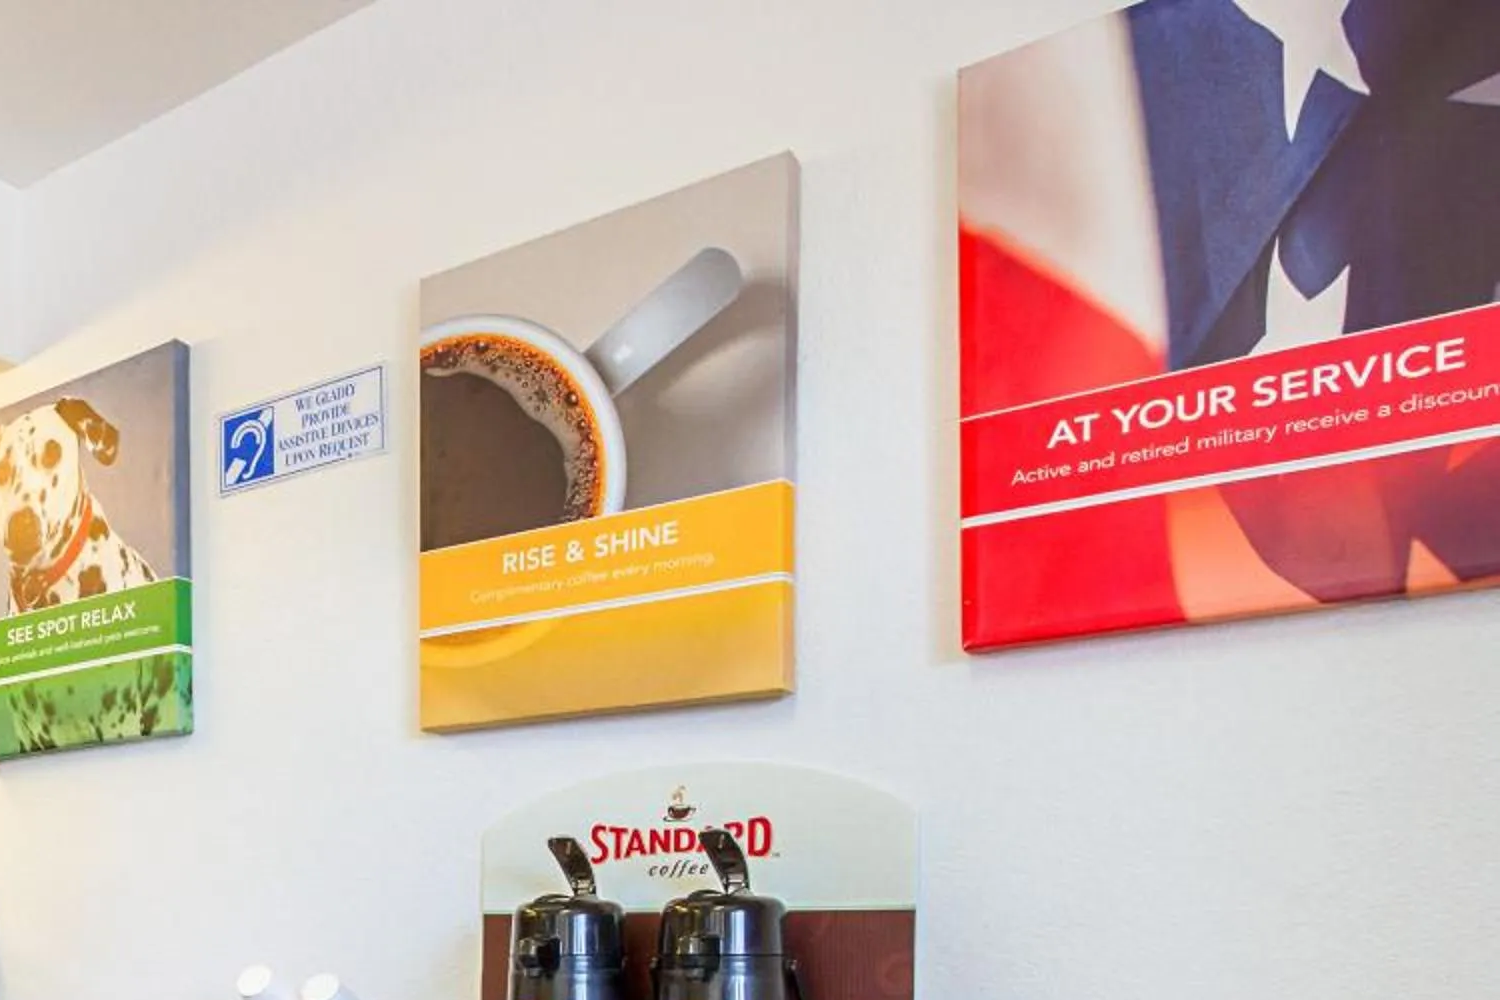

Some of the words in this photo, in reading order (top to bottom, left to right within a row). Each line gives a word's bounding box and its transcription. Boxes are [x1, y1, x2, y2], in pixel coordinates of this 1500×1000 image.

[1047, 413, 1100, 449] AT
[1112, 384, 1236, 435] YOUR
[1251, 336, 1467, 407] SERVICE
[301, 403, 348, 429] PROVIDE
[331, 413, 379, 437] DEVICES
[1012, 463, 1071, 487] Active
[1078, 452, 1115, 474] and
[1121, 436, 1189, 465] retired
[1197, 424, 1277, 449] military
[1285, 405, 1370, 433] receive
[1377, 404, 1392, 419] a
[1399, 383, 1500, 414] discoun
[503, 545, 556, 576] RISE
[565, 540, 584, 562] &
[594, 520, 679, 558] SHINE
[612, 563, 649, 580] every
[7, 625, 34, 646] SEE
[37, 614, 78, 640] SPOT
[81, 602, 137, 629] RELAX
[591, 816, 772, 864] STANDD
[648, 859, 709, 878] coffee
